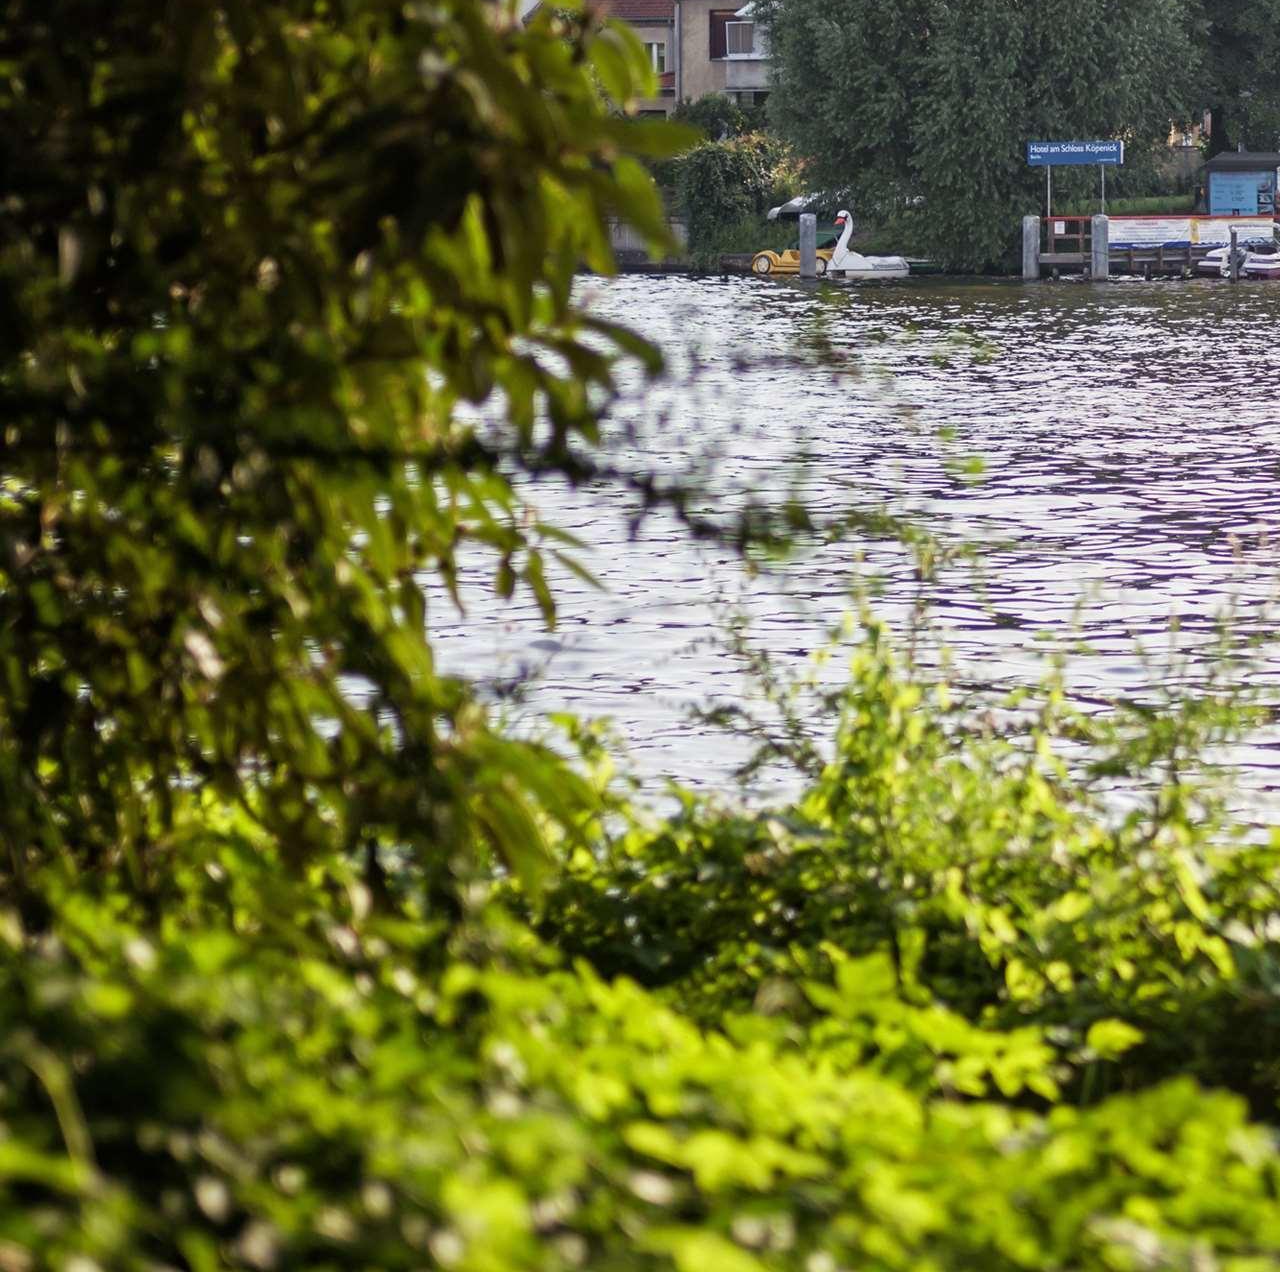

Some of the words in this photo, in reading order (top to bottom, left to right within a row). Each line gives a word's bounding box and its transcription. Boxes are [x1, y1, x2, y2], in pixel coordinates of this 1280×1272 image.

[1030, 144, 1049, 153] Hotel
[1061, 144, 1084, 153] Schloss
[1085, 143, 1118, 154] Köpenick
